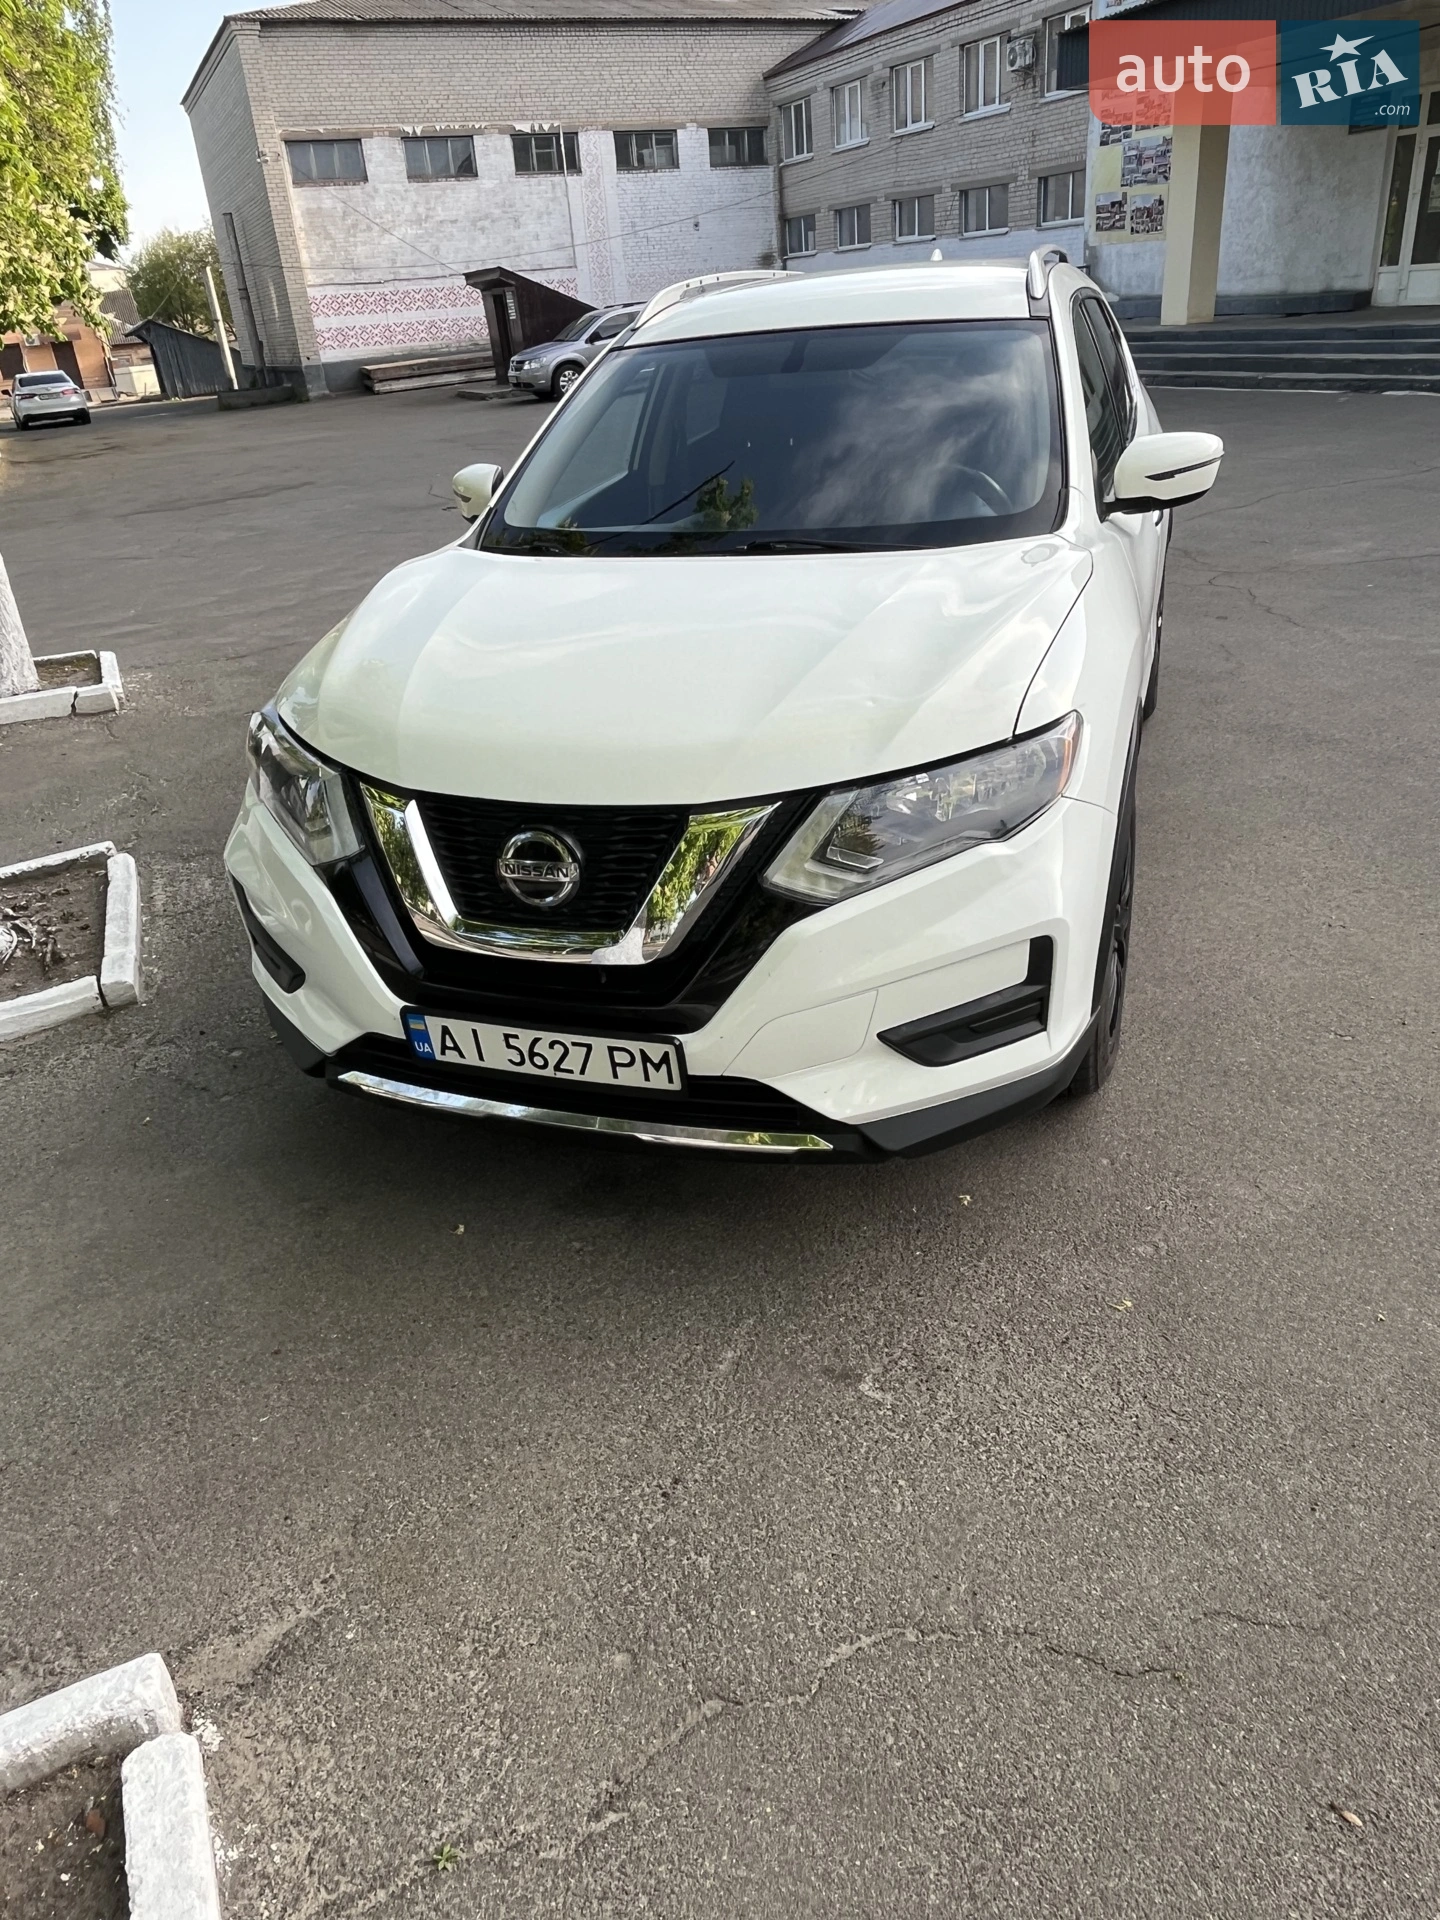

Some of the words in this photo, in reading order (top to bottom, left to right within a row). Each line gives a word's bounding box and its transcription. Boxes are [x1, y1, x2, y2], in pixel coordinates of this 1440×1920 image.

[503, 863, 569, 878] NISSAN
[415, 1041, 433, 1054] UA
[440, 1025, 486, 1062] AI
[502, 1032, 593, 1076] 5627
[606, 1045, 675, 1084] PM
